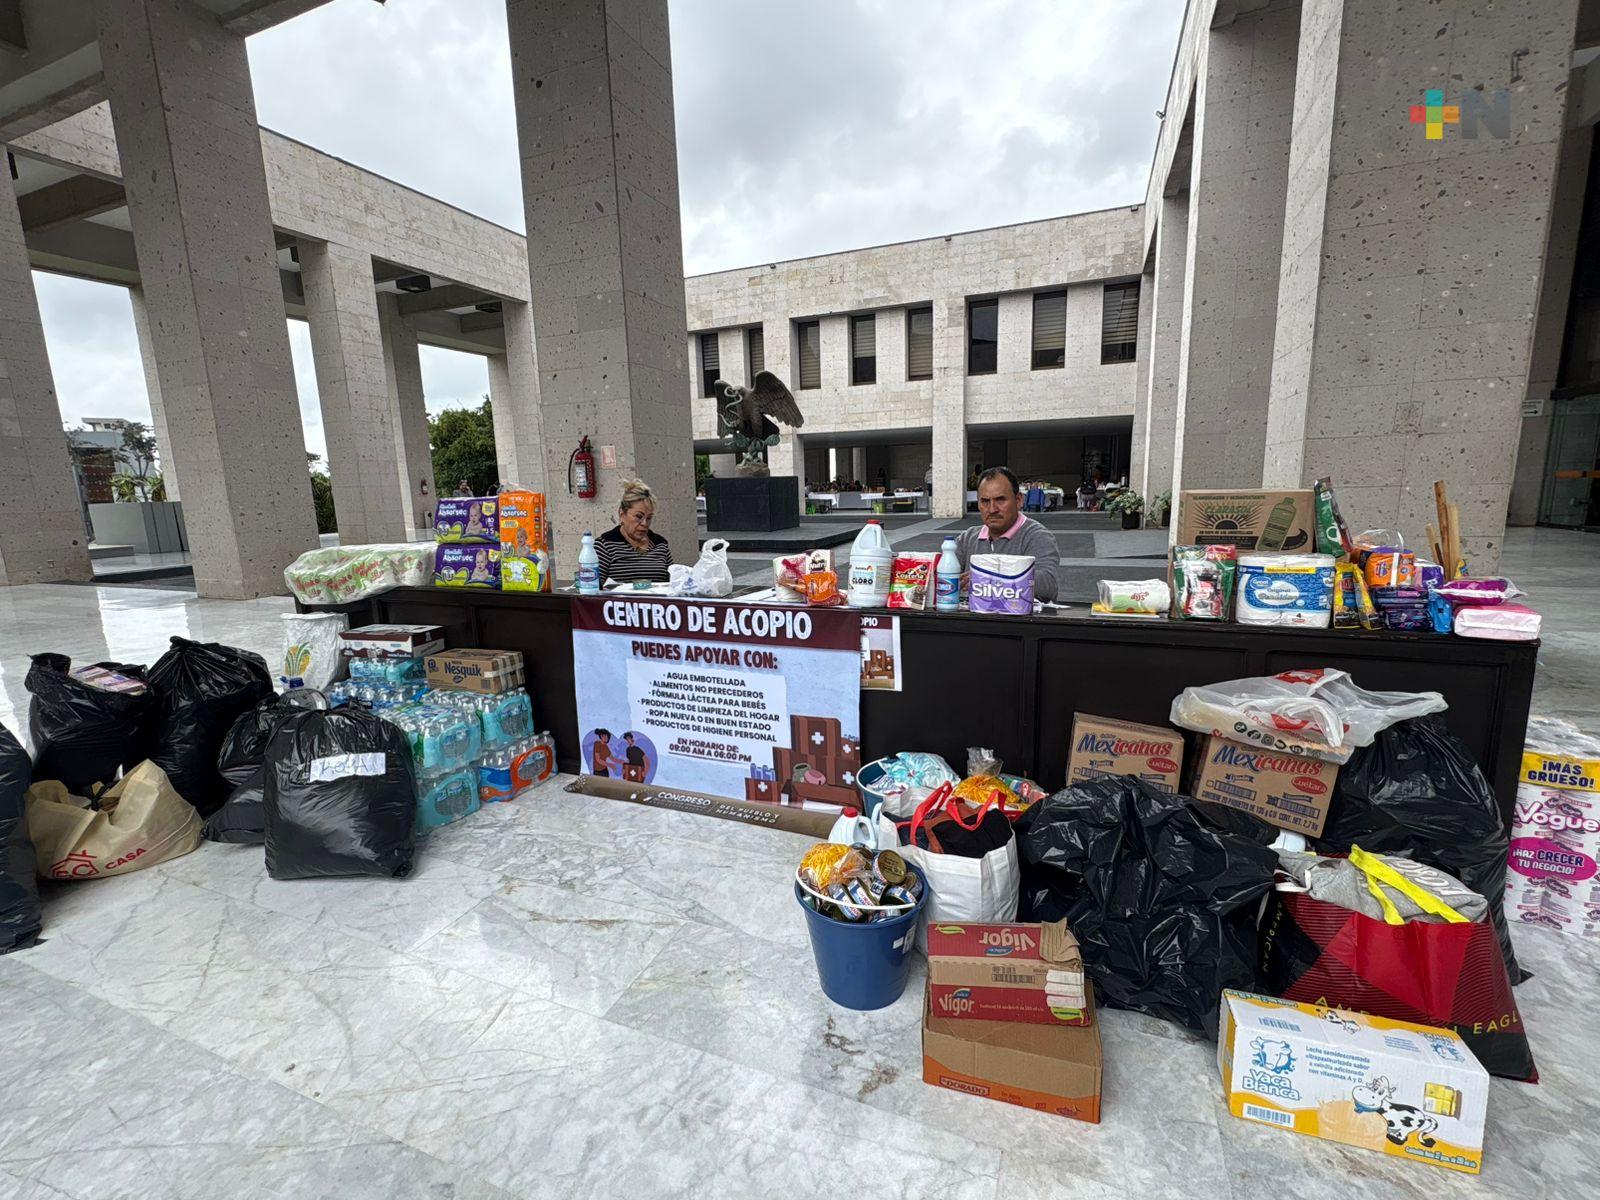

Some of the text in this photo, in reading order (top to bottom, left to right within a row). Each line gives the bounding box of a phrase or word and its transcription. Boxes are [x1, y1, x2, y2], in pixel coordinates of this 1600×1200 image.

[852, 577, 874, 585] CLORO
[971, 583, 1023, 598] Silver
[603, 600, 812, 640] CENTRO DE ACOPIO
[631, 640, 778, 669] PUEDES APOYAR CON:
[444, 661, 482, 678] Nesquik
[667, 672, 746, 687] AGUA EMBOTELLADA
[653, 680, 764, 699] ALIMENTOS NO PERECEDEROS
[652, 688, 766, 710] FÓRMULA LÁCTEA PARA BEBÉS
[641, 698, 780, 722] PRODUCTOS DE LIMPIEZA DEL HOGAR
[649, 709, 771, 731] ROPA NUEVA O EN BUEN ESTADO
[646, 718, 777, 742] PRODUCTOS DE HIGIENE PERSONAL
[677, 737, 739, 753] EN HORARIO DE:
[1077, 733, 1173, 757] Mexicanas
[692, 747, 705, 756] AM
[706, 749, 713, 757] A
[738, 754, 752, 762] PM
[1212, 745, 1325, 776] Mexicanas
[1528, 770, 1595, 788] GRUESO!
[657, 791, 711, 807] CONGRESO
[715, 809, 777, 824] HUMANISMO
[739, 807, 771, 818] PUEBLO
[1515, 801, 1600, 833] Vogue
[105, 847, 147, 870] CASA
[1519, 858, 1530, 867] TU
[1537, 850, 1584, 867] CRECER
[978, 928, 1036, 952] Vigor
[938, 992, 975, 1016] Vigor
[1305, 1045, 1323, 1055] Leche
[1334, 1066, 1365, 1077] adicionada
[1353, 1062, 1370, 1070] sabor
[1249, 1068, 1292, 1089] Vaca
[1320, 1070, 1346, 1081] vitaminas
[947, 1080, 987, 1095] DORADO
[1242, 1075, 1300, 1101] Blanca
